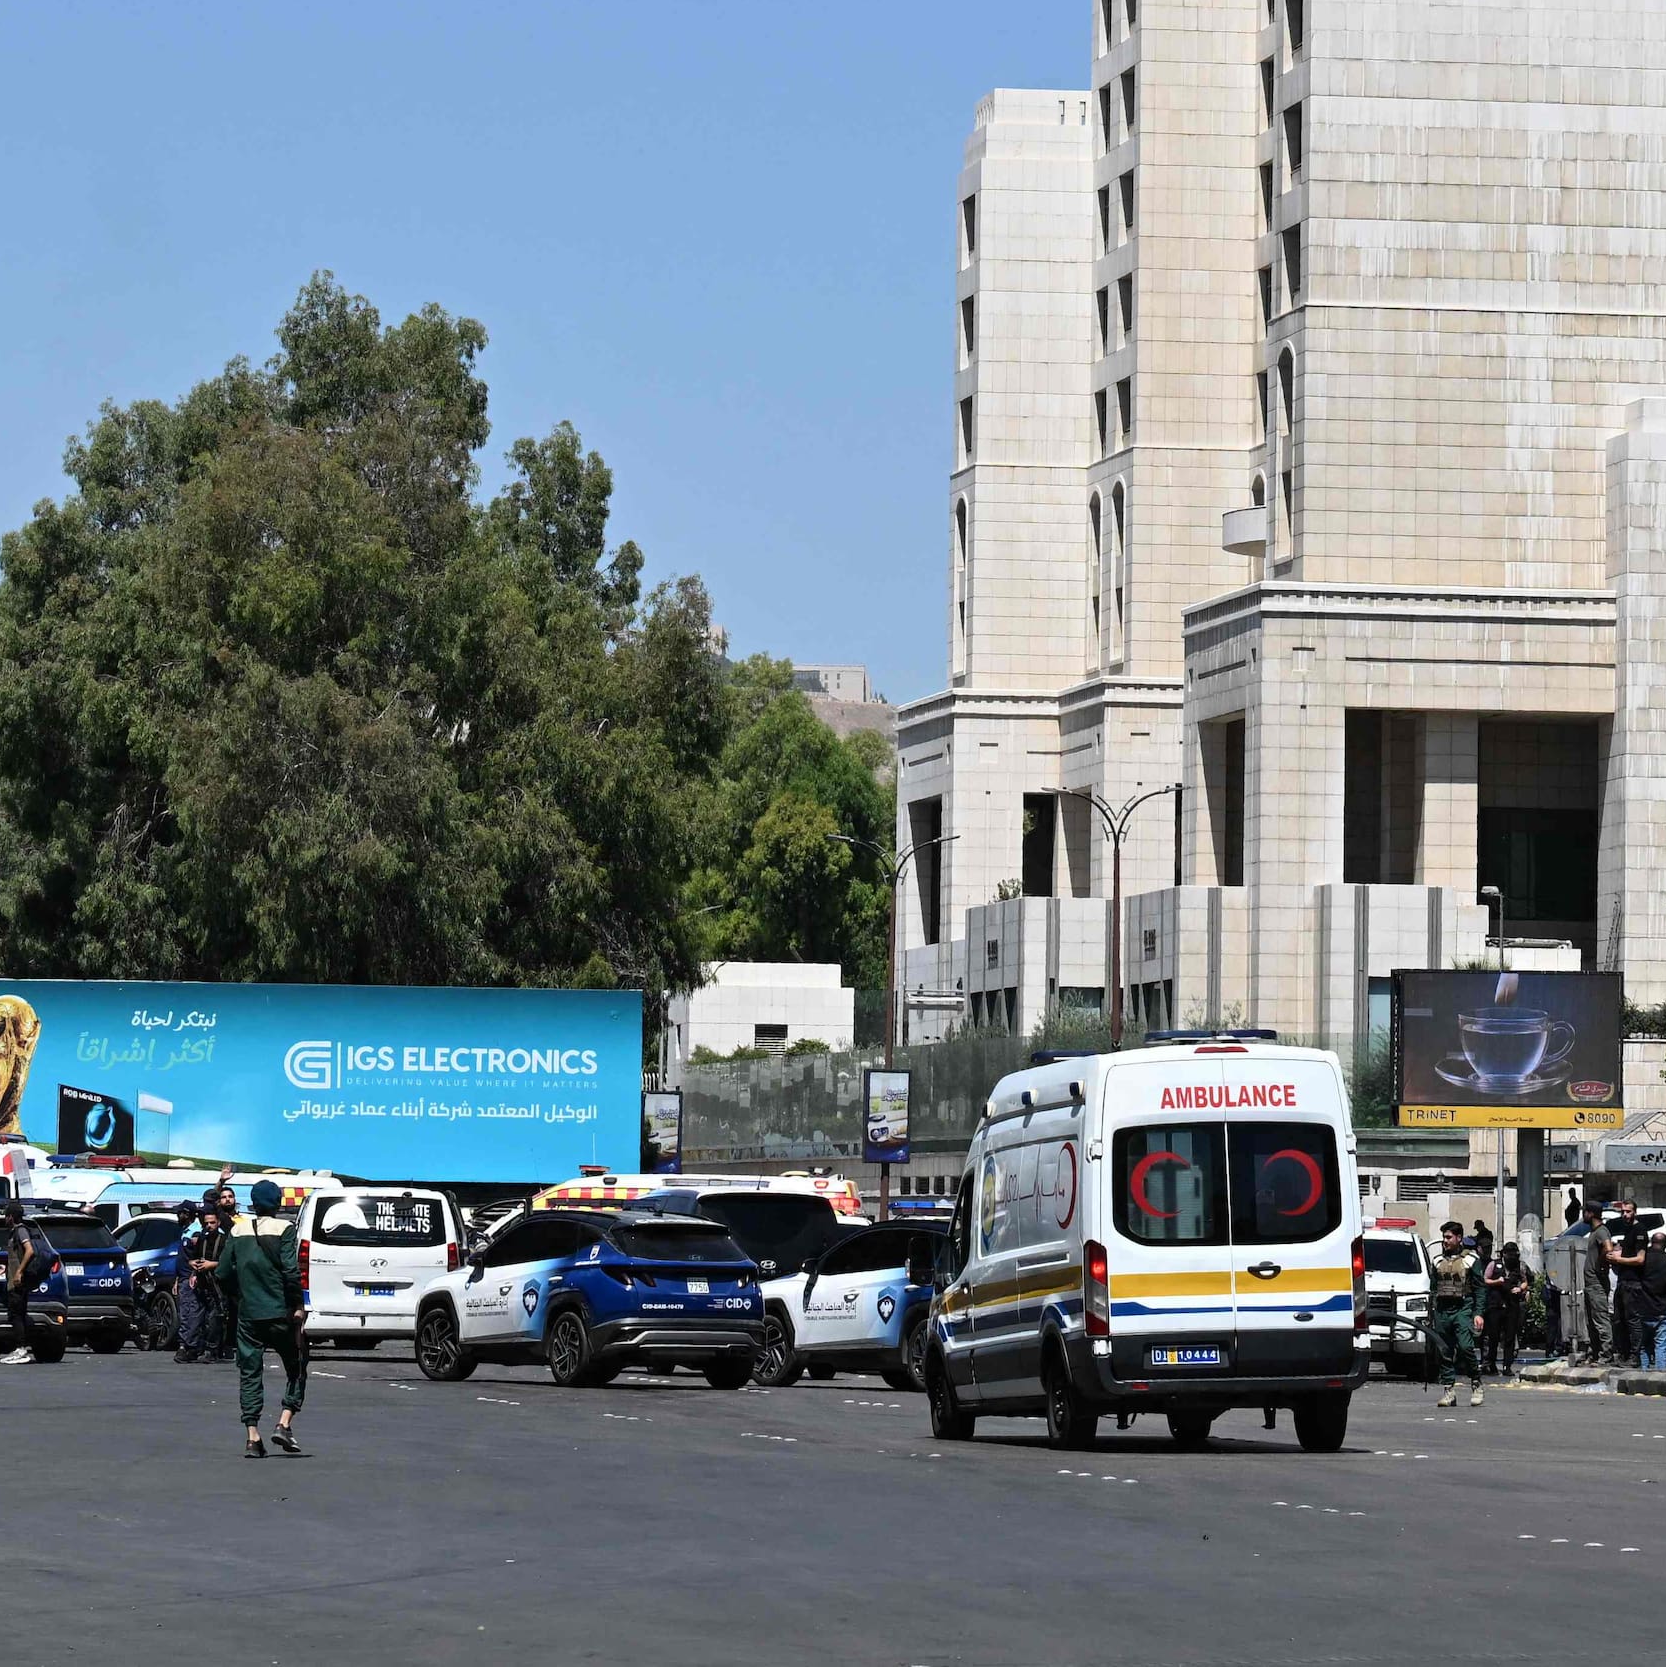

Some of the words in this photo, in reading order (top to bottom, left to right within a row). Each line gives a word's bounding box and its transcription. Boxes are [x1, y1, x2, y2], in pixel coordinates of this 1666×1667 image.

[131, 1010, 173, 1030] لحياة
[173, 1011, 217, 1032] نبتكر
[158, 1035, 216, 1071] أكثر
[346, 1045, 395, 1072] IGS
[403, 1046, 598, 1075] ELECTRONICS
[346, 1077, 422, 1086] DELIVERING
[429, 1078, 468, 1087] VALUE
[475, 1079, 517, 1088] WHERE
[542, 1080, 598, 1090] MATTERS
[1160, 1084, 1297, 1109] AMBULANCE
[351, 1101, 386, 1116] عماد
[391, 1098, 424, 1119] أبناء
[428, 1100, 472, 1121] شركة
[477, 1103, 540, 1119] المعتمد
[544, 1104, 598, 1123] الوكيل
[1587, 1113, 1616, 1124] 8090
[376, 1201, 395, 1215] THE
[375, 1216, 430, 1233] HELMETS
[98, 1278, 114, 1287] CID
[725, 1298, 743, 1309] CID
